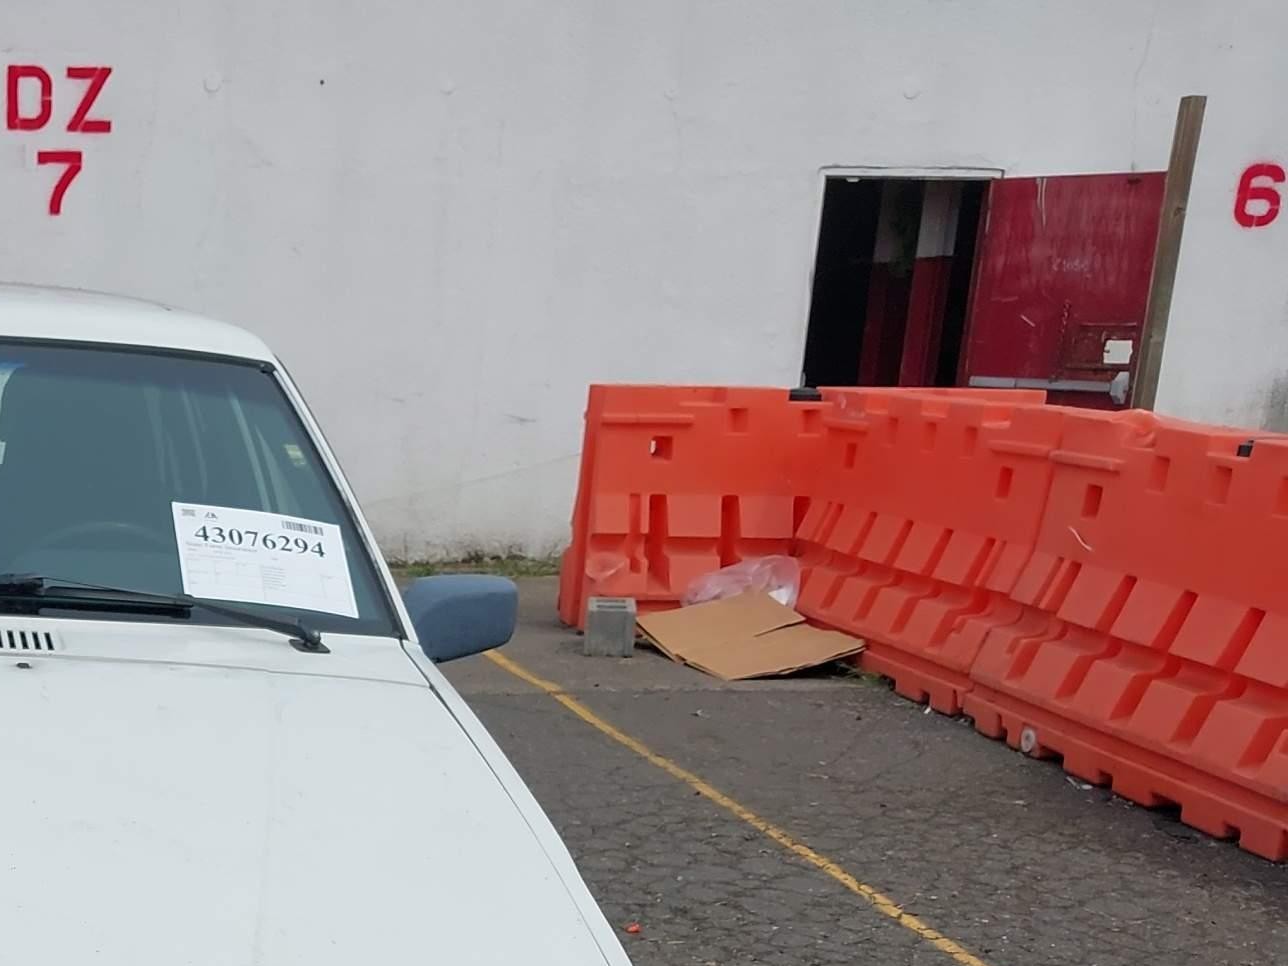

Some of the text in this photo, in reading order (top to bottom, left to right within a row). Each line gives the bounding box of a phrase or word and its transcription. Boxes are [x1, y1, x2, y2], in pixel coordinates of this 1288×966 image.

[6, 65, 112, 133] DZ
[37, 150, 83, 216] 7
[1234, 163, 1286, 228] 6
[194, 525, 326, 558] 43076294
